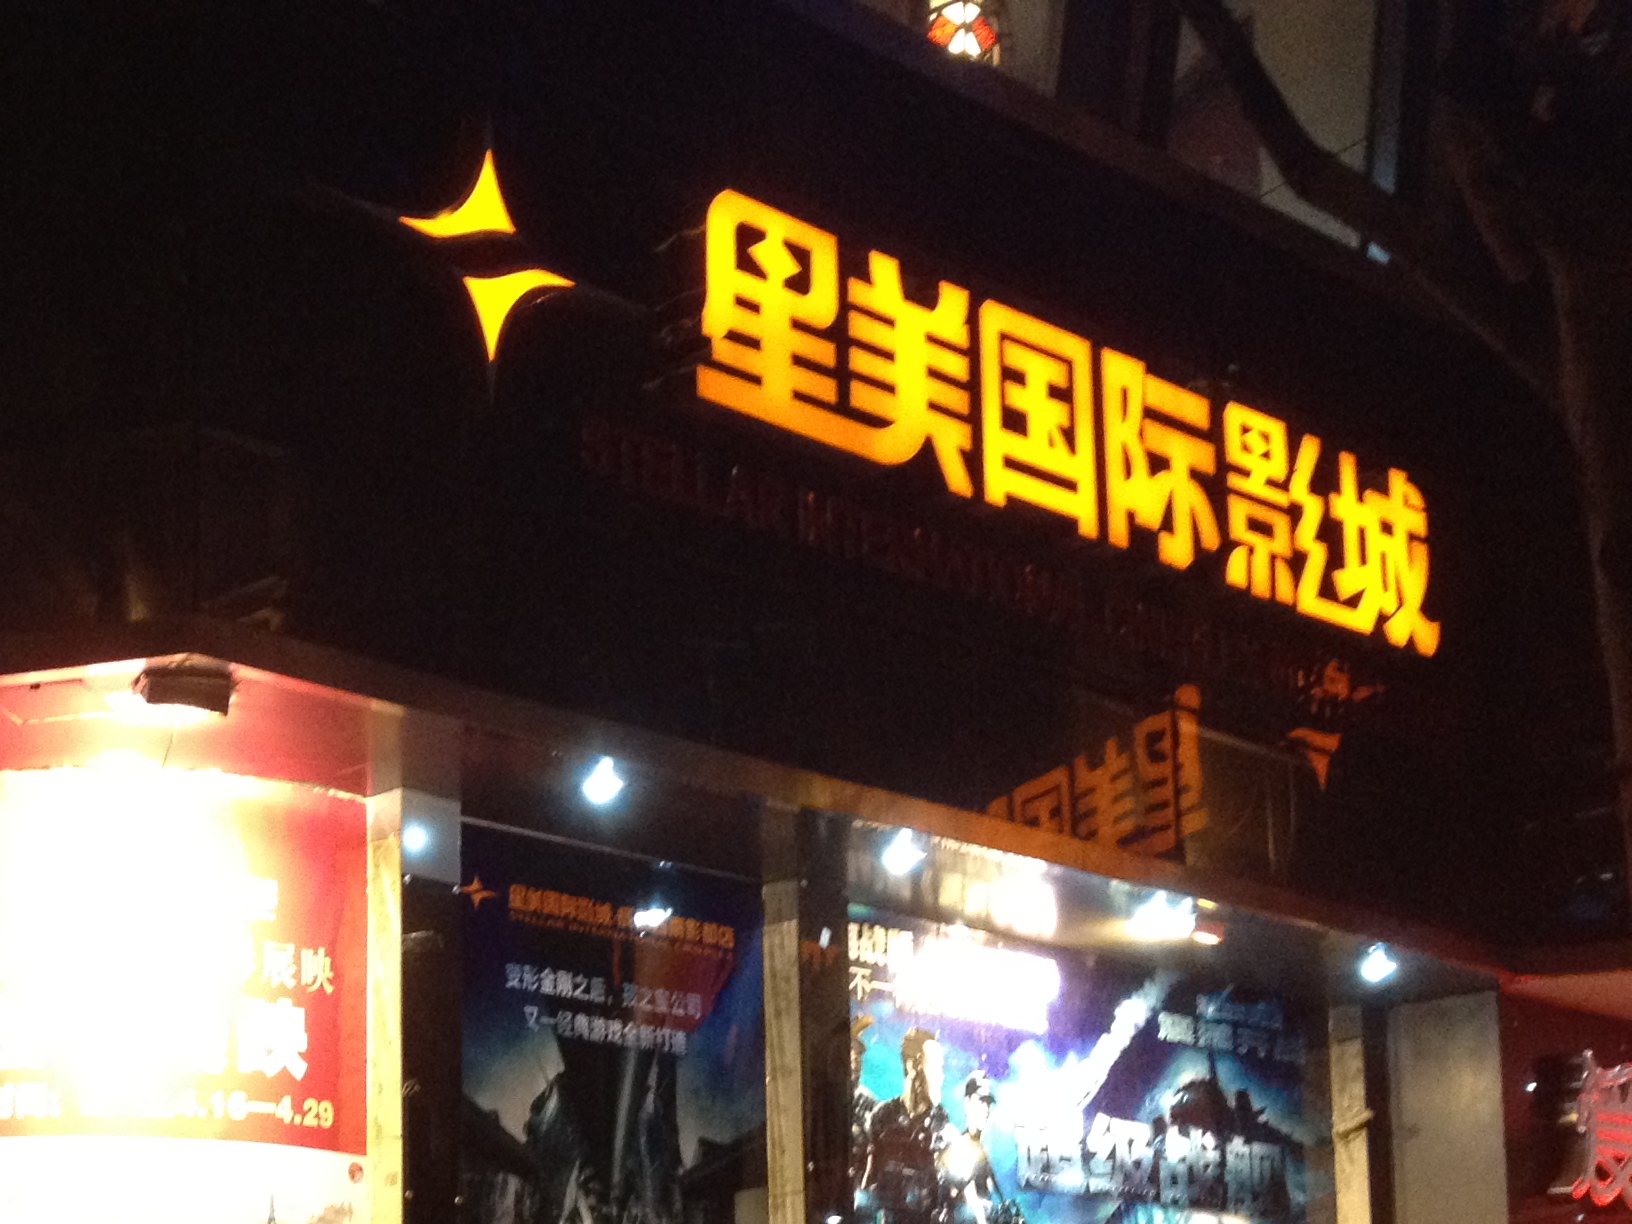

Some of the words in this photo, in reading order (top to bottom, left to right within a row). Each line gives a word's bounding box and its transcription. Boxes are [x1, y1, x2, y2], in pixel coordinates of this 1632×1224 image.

[697, 189, 1440, 657] 星美国际影城
